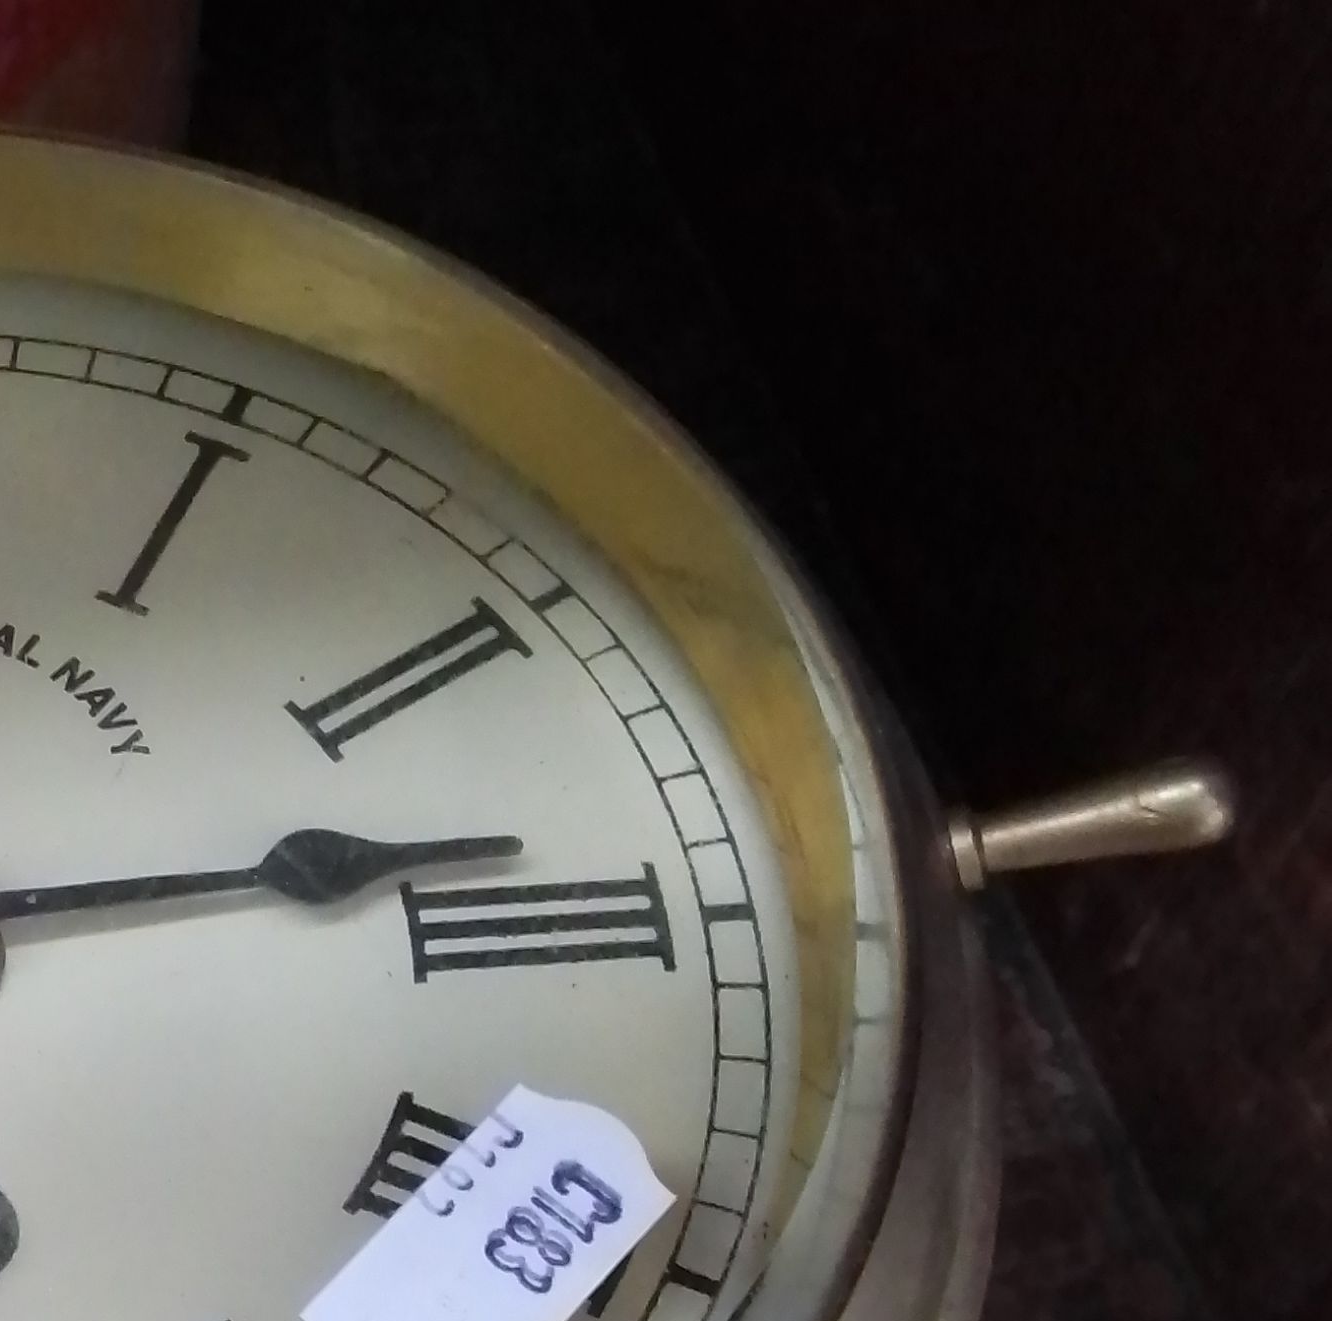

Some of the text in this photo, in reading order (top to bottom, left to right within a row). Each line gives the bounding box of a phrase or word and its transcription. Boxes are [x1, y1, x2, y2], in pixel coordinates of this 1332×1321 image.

[94, 430, 251, 617] I
[49, 656, 151, 756] NAVY
[284, 596, 534, 763] II
[398, 861, 676, 984] III
[484, 1159, 623, 1294] C183
